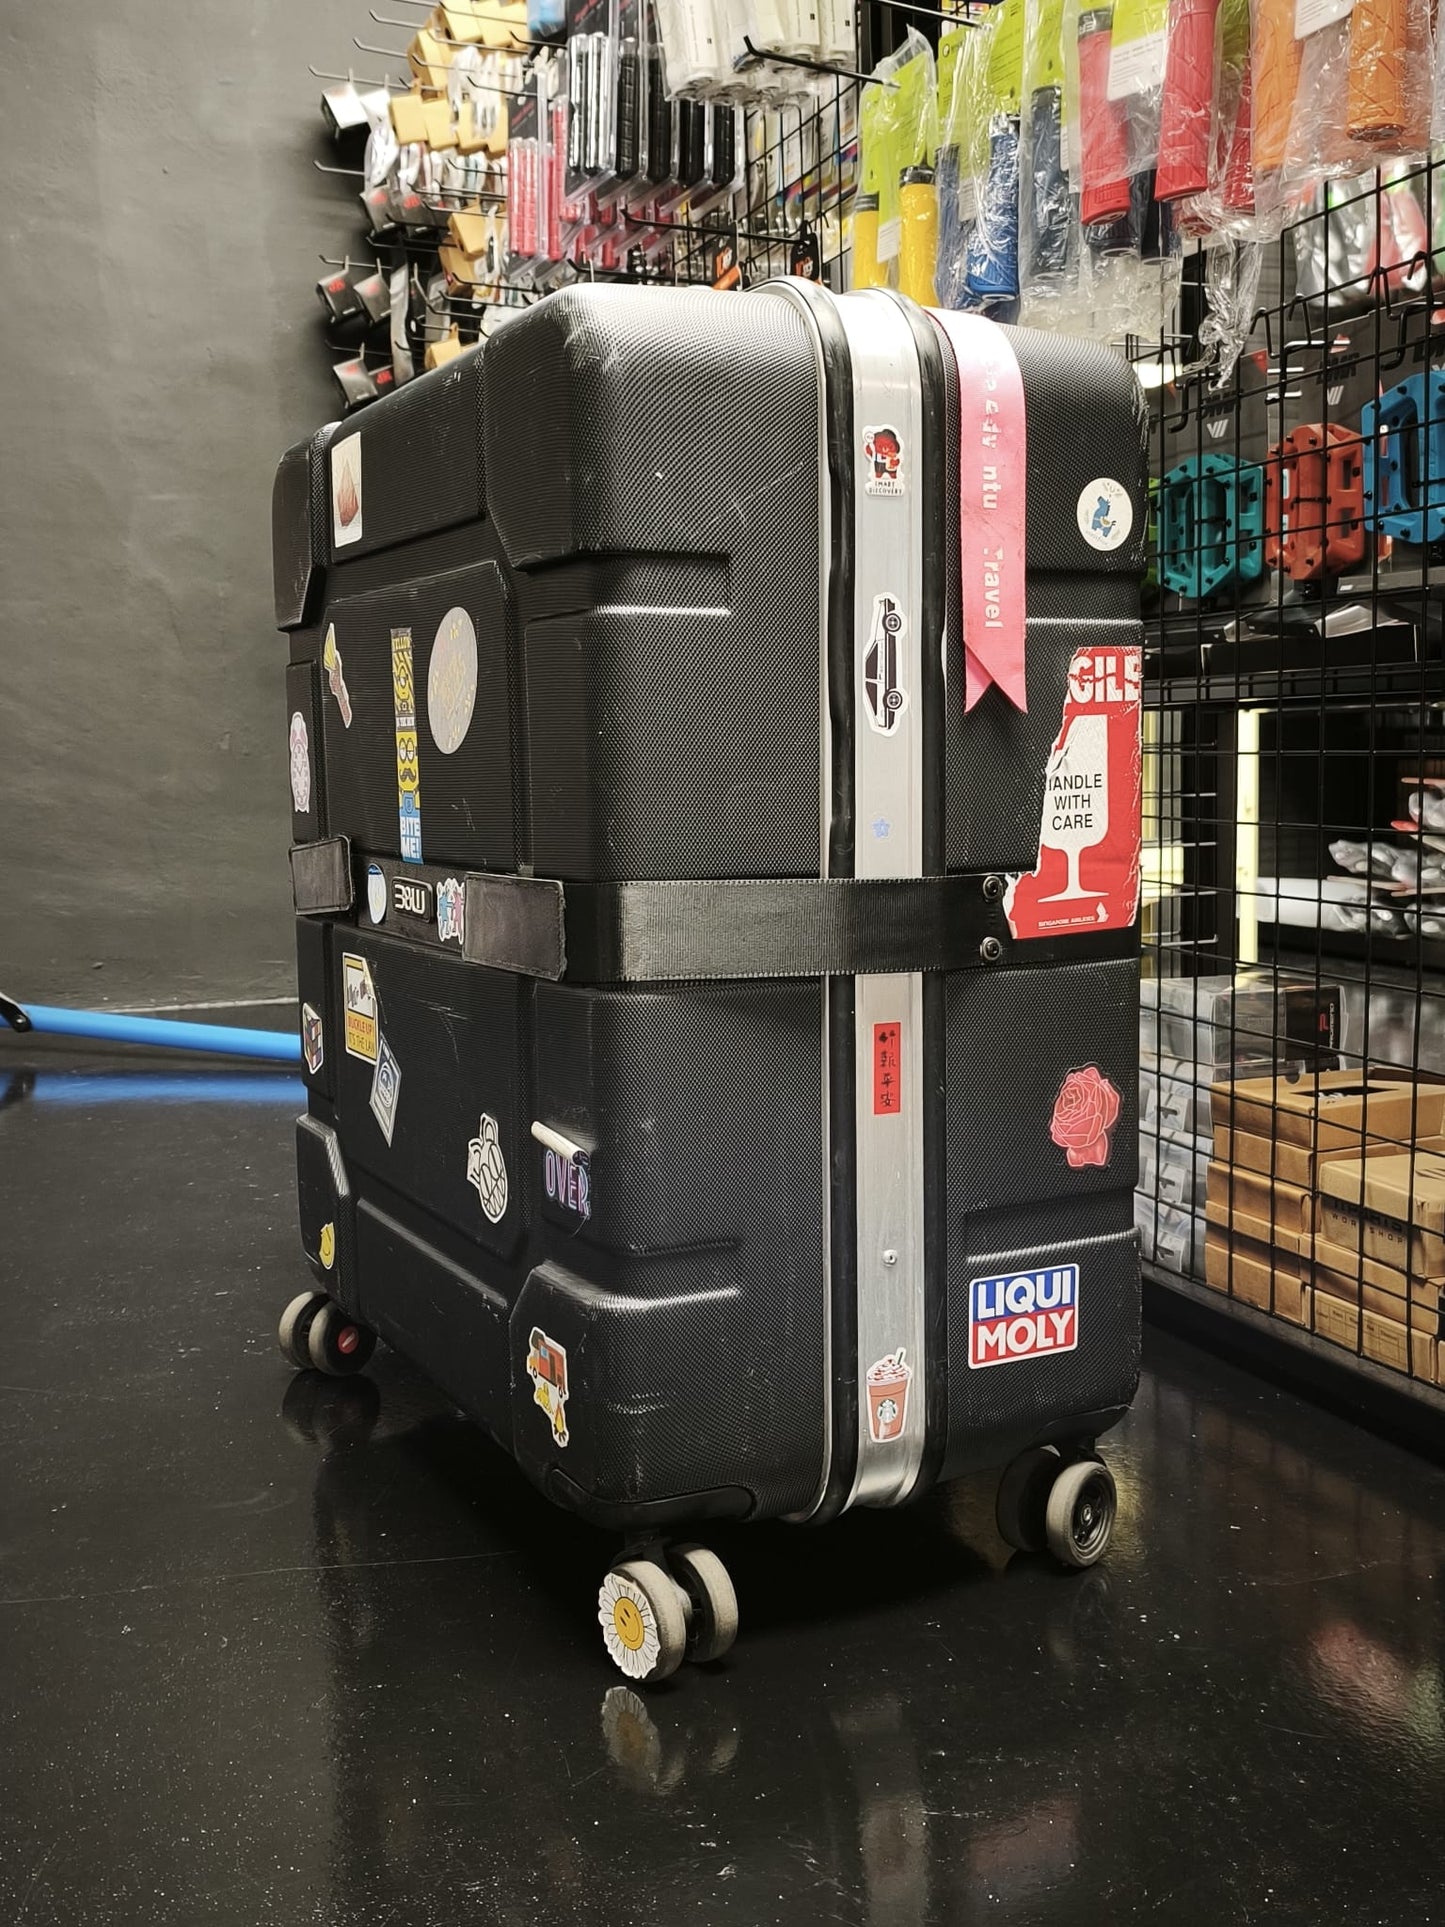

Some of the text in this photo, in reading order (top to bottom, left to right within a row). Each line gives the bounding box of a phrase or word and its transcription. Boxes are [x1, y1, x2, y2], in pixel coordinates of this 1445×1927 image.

[1066, 656, 1140, 704] GILE
[1054, 794, 1091, 811] WITH
[401, 816, 420, 837] BITE
[1052, 813, 1093, 831] CARE
[401, 837, 421, 859] ME!
[1332, 1212, 1404, 1245] WORSHOP
[977, 1270, 1072, 1320] LIQUI
[977, 1309, 1074, 1361] MOLY
